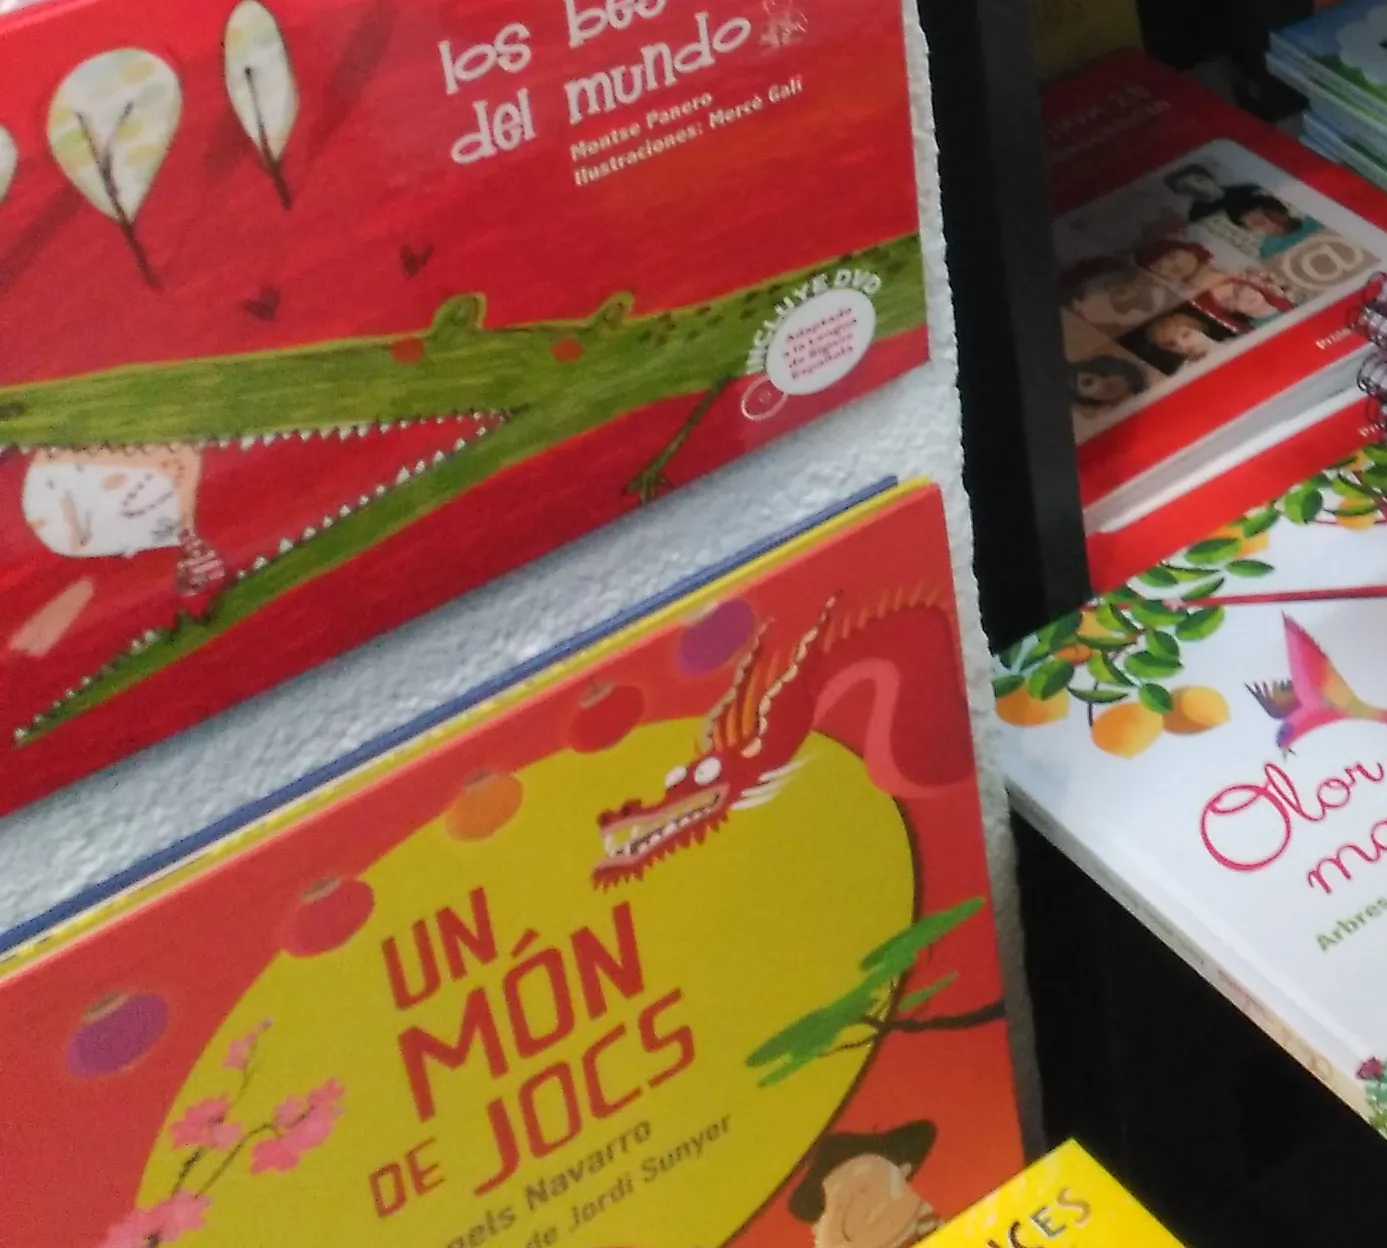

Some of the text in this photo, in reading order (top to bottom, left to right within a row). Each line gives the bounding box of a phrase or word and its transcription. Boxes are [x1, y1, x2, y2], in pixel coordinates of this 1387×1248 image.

[438, 22, 532, 95] los
[451, 11, 752, 164] del mundo
[569, 91, 714, 162] Montse Panero
[573, 122, 704, 187] Ilustraciones:
[708, 94, 764, 129] Mercè
[745, 268, 883, 376] INCLUYE DVD
[1199, 760, 1386, 872] Olor
[379, 886, 500, 1013] UN
[398, 901, 647, 1124] MÓN
[368, 987, 699, 1220] DE JOCS
[523, 1118, 653, 1210] Navarro
[567, 1171, 635, 1234] Jordi
[639, 1113, 733, 1184] Sunyer
